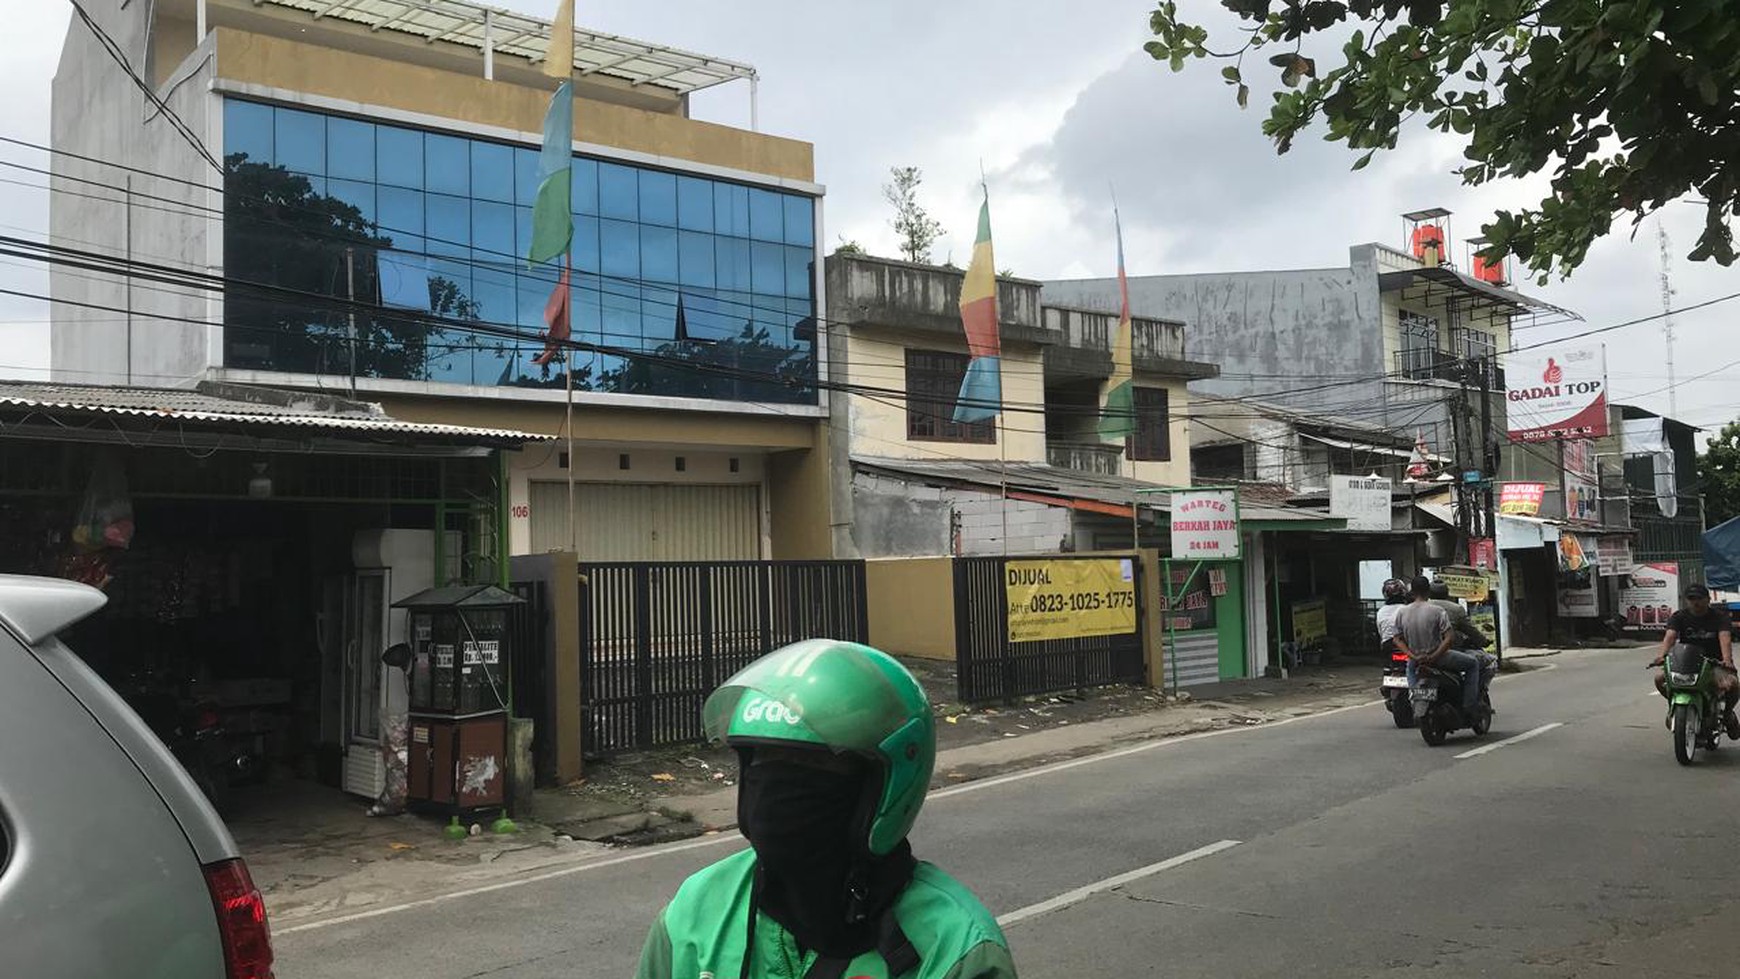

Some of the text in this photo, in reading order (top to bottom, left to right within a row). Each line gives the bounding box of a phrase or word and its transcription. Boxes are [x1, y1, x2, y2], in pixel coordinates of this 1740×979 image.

[1508, 381, 1601, 402] GADAI TOP
[1503, 484, 1543, 493] DIJUAL
[512, 506, 528, 518] 106
[1181, 500, 1227, 512] WARTEG
[1173, 520, 1236, 532] BERKAH JAYA
[1190, 541, 1219, 550] 24 JAM
[1009, 569, 1052, 586] DIJUAL
[1030, 591, 1133, 613] 0823-1025-1775
